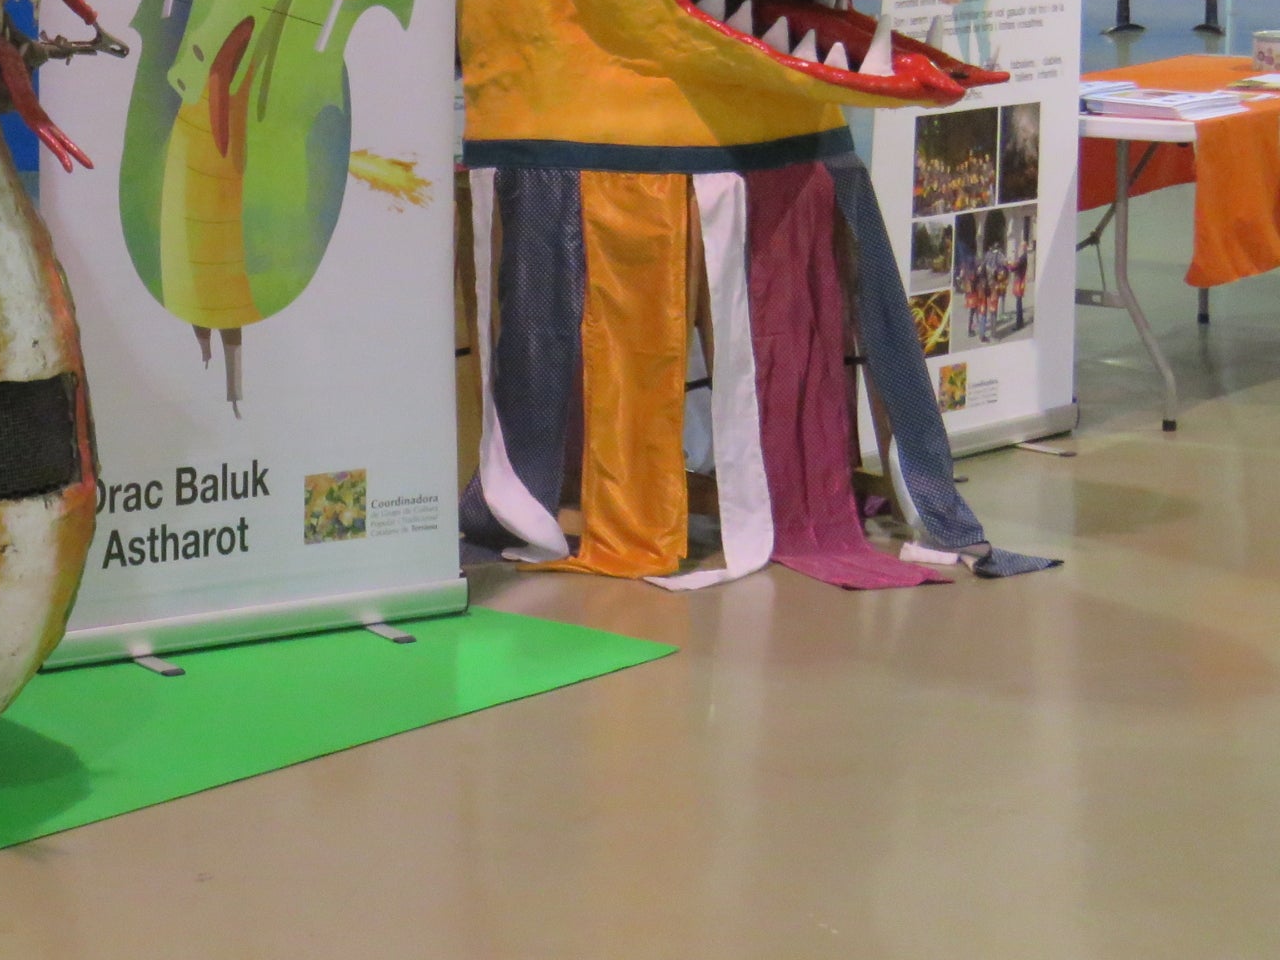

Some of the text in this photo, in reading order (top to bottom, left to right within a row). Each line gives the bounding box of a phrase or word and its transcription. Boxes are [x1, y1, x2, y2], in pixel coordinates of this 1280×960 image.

[176, 460, 270, 506] Baluk
[371, 494, 439, 509] Coordinadora
[102, 517, 249, 569] Astharot
